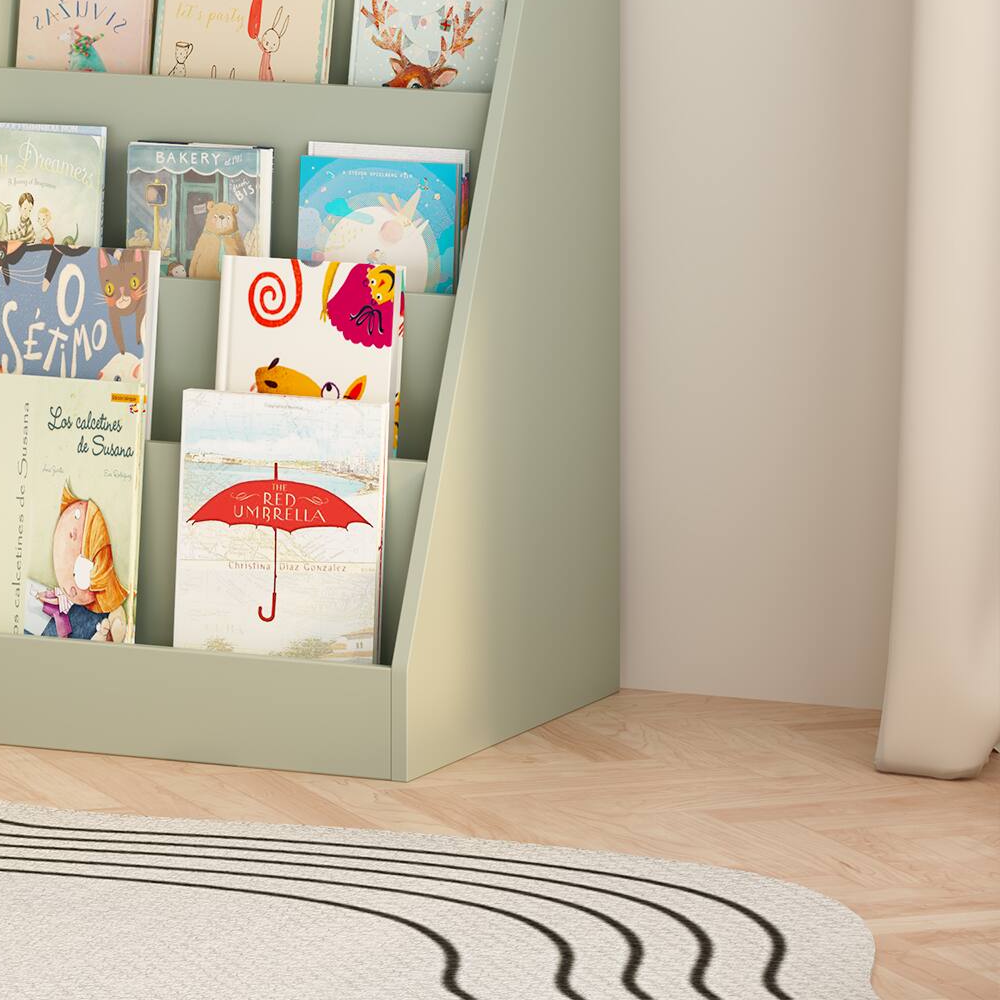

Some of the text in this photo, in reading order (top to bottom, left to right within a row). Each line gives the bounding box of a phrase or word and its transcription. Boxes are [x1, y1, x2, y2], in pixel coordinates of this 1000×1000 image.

[156, 151, 220, 165] BAKERY
[57, 263, 85, 326] O
[48, 406, 122, 432] Los calcetines
[17, 402, 29, 478] Susana
[77, 434, 134, 457] de Susana
[16, 485, 25, 507] de
[272, 483, 288, 491] THE
[263, 492, 296, 507] RED
[234, 505, 326, 523] UMBRELLA
[12, 514, 25, 607] calcetines
[228, 561, 271, 570] Christina
